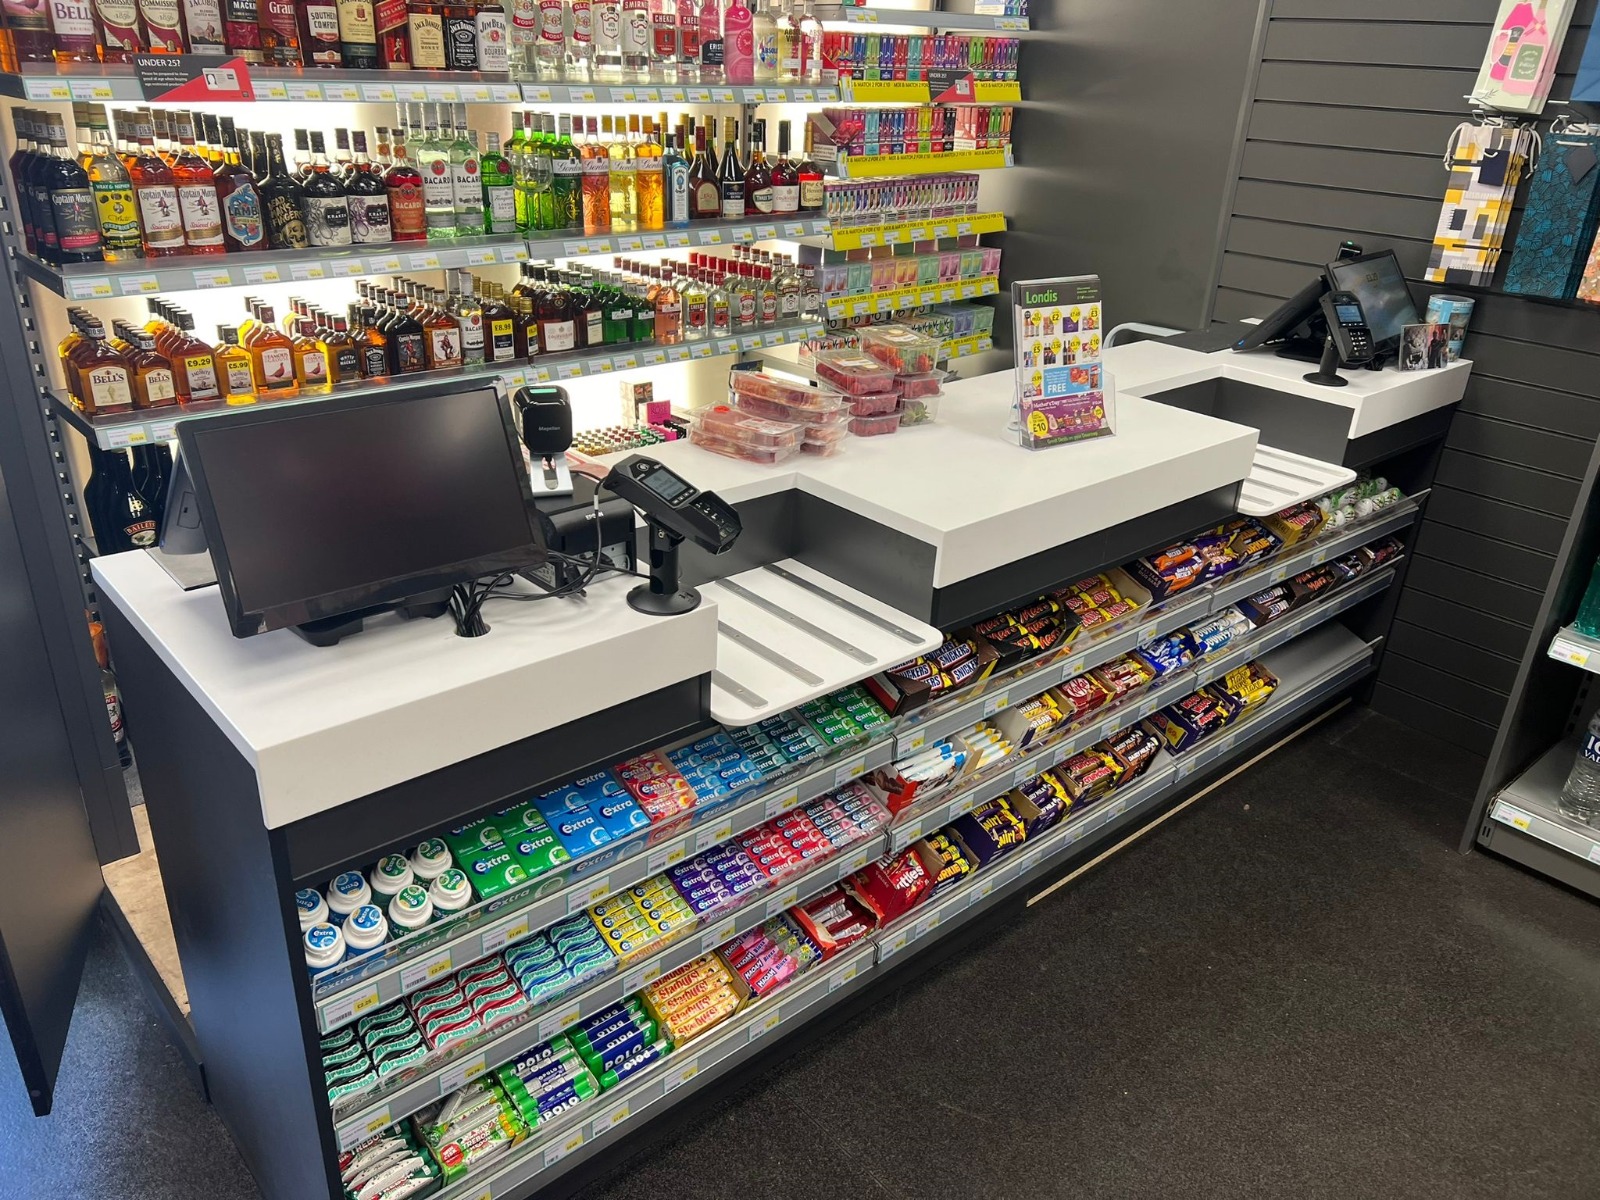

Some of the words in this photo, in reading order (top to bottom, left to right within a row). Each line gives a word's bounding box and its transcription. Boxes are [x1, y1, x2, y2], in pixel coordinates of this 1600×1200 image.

[55, 2, 95, 19] BELL
[269, 2, 294, 14] Gran
[138, 59, 168, 67] UNDER
[168, 59, 181, 67] 25?
[424, 176, 450, 185] BACARD
[228, 206, 259, 217] LAMB
[1025, 289, 1058, 304] Londis
[1034, 345, 1041, 353] £5
[187, 356, 212, 368] £9.29
[228, 361, 249, 370] £5.99
[92, 371, 125, 385] BELL'S
[148, 374, 170, 384] BELL'S
[1047, 383, 1067, 393] FREE
[1033, 422, 1046, 432] £10
[940, 643, 971, 666] SNICKERS
[901, 664, 929, 679] ICKERS
[833, 734, 852, 745] extra
[720, 766, 741, 779] extra
[603, 800, 634, 816] extra
[562, 816, 595, 834] extra
[520, 835, 554, 854] extra
[802, 846, 822, 858] extra
[475, 852, 511, 873] extra
[769, 863, 789, 876] extra
[896, 865, 925, 890] ittles
[734, 880, 754, 894] extra
[488, 889, 530, 912] extra
[698, 898, 720, 912] extra
[313, 929, 335, 937] extra
[406, 936, 440, 954] extra
[744, 961, 762, 979] MAOAM
[317, 974, 354, 994] extra
[757, 969, 776, 989] MAOAM
[517, 1048, 552, 1072] POLO
[604, 1044, 643, 1071] POLO
[543, 1096, 580, 1122] POLO
[351, 1130, 386, 1155] TREBOR
